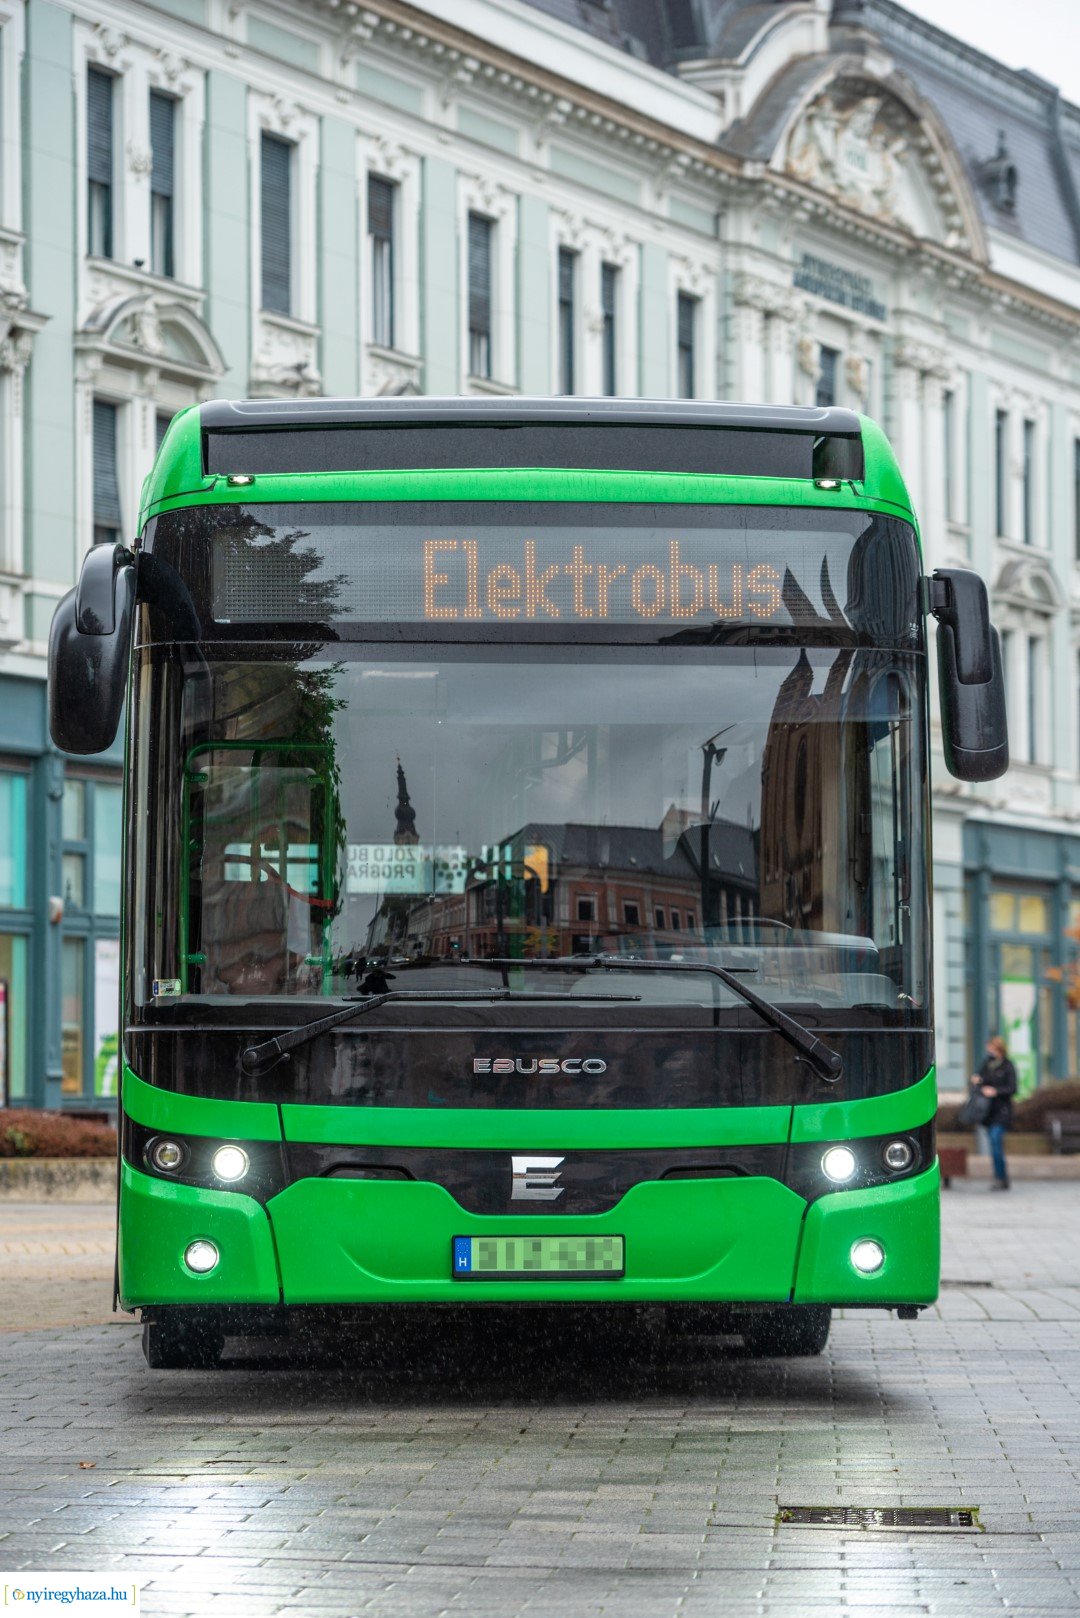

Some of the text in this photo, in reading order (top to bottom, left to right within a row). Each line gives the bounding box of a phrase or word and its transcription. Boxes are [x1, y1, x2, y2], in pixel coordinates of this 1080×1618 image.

[424, 538, 781, 619] Elektrobus
[473, 1058, 607, 1074] EBUSCO
[511, 1156, 565, 1200] E
[458, 1257, 467, 1267] H
